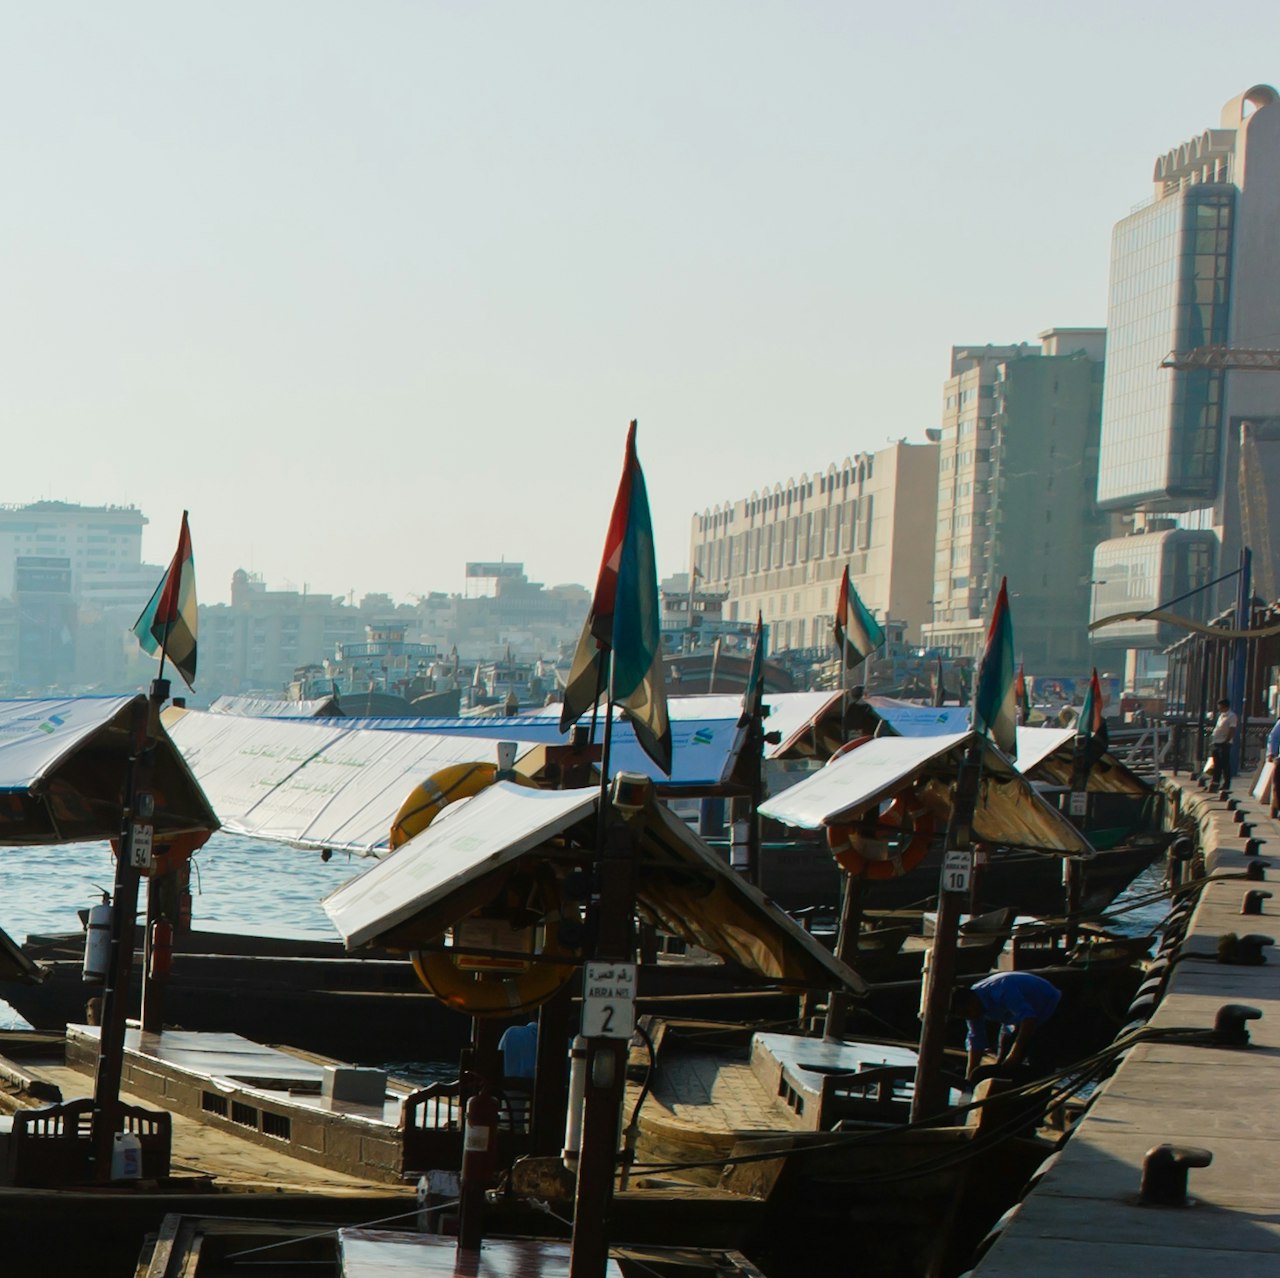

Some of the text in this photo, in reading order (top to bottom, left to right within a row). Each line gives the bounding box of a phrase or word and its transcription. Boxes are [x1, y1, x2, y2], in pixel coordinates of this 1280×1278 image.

[135, 848, 146, 864] 54
[950, 872, 964, 888] 10
[601, 1005, 615, 1033] 2
